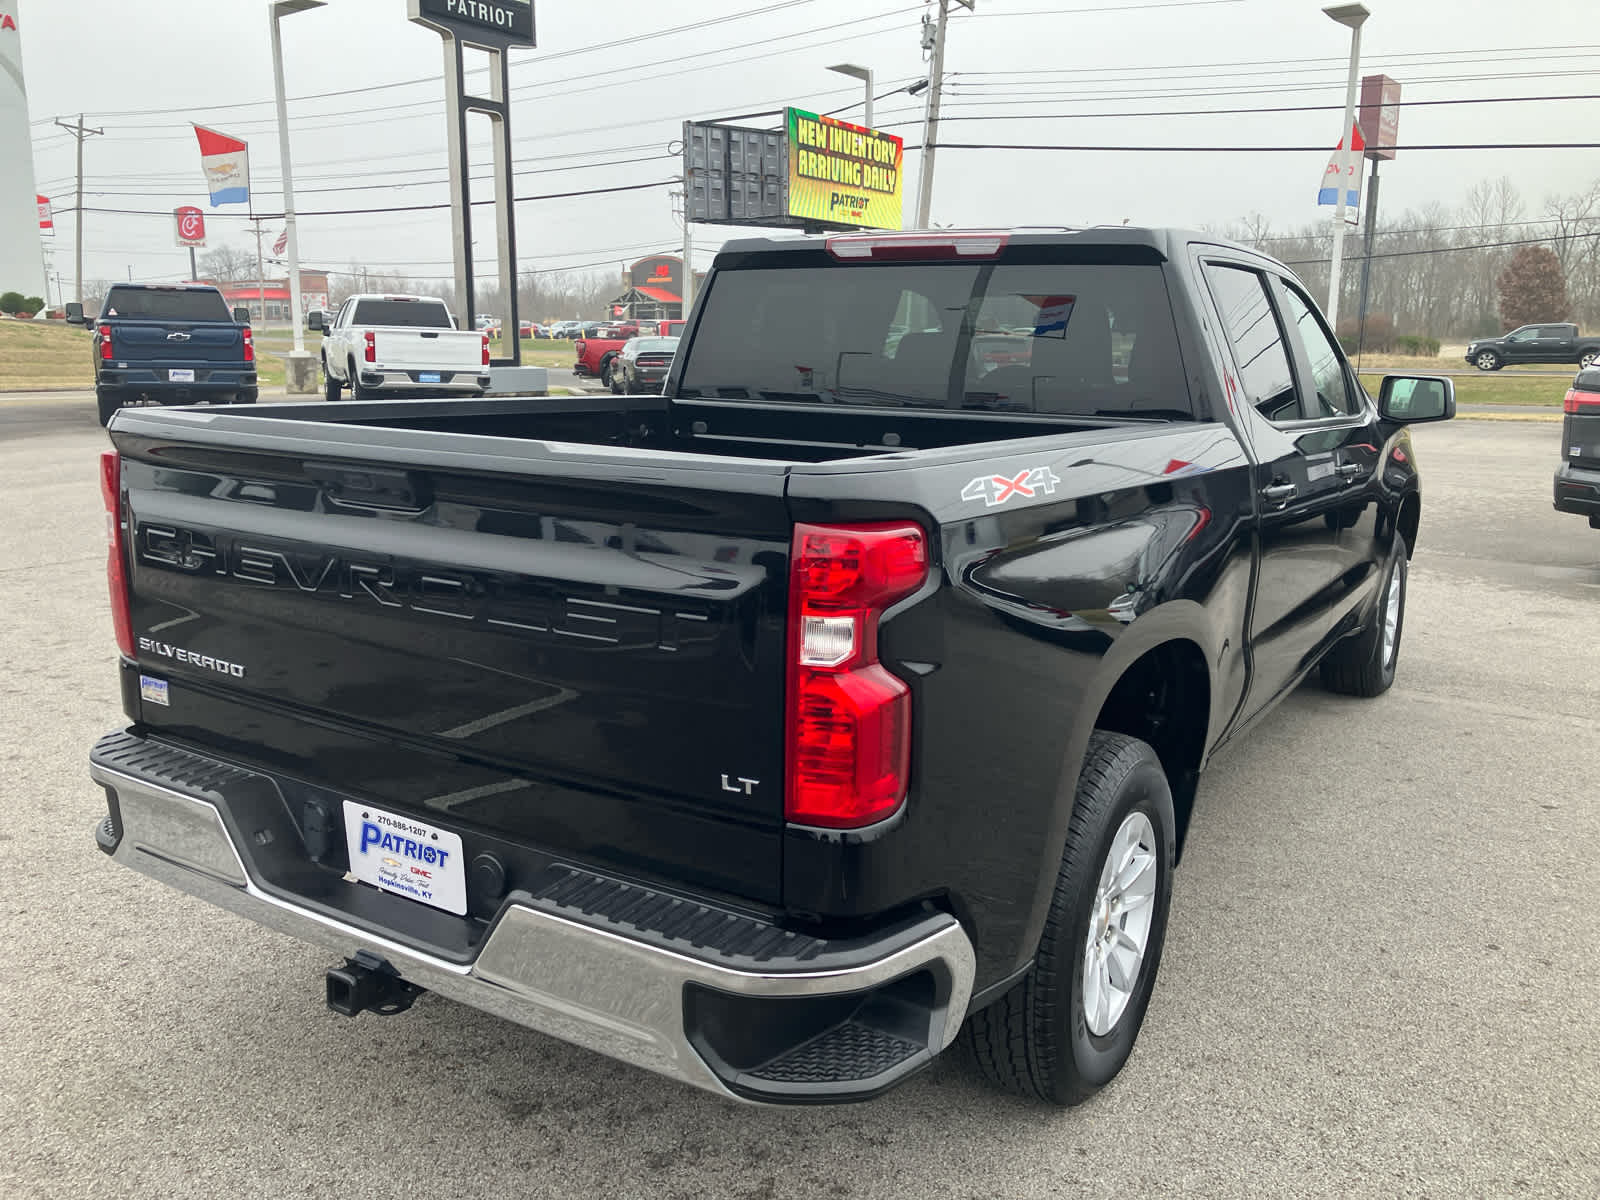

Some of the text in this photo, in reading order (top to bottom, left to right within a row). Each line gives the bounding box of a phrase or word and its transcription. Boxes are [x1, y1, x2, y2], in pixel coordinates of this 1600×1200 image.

[447, 0, 514, 28] PATRIOT
[798, 117, 897, 165] NEW INVENTORY
[798, 149, 896, 193] ARRIVING DAILY
[830, 192, 870, 210] PATRIOT
[138, 522, 710, 652] CHEVROLET
[138, 636, 246, 679] SILVERADO
[720, 773, 760, 795] LT
[377, 815, 427, 837] 270-886-1207
[360, 821, 449, 868] PATRIOT
[410, 866, 433, 880] GMC
[422, 890, 433, 900] KY
